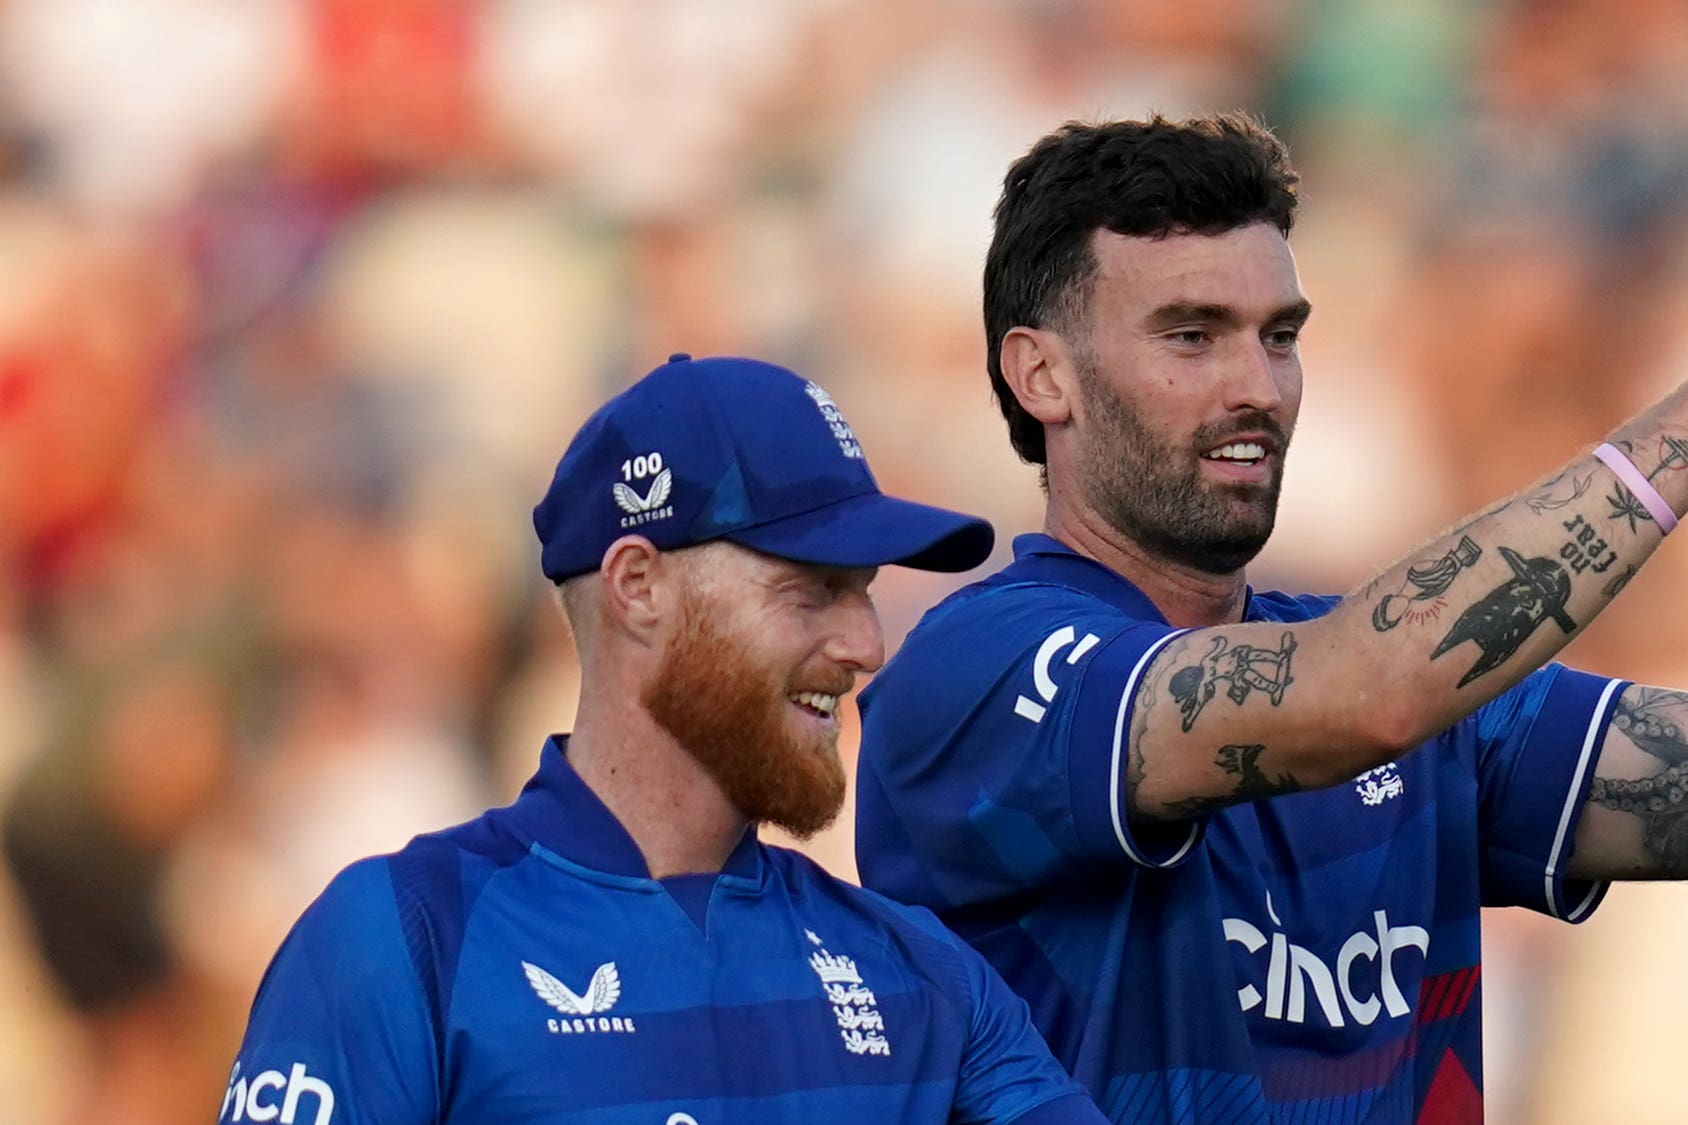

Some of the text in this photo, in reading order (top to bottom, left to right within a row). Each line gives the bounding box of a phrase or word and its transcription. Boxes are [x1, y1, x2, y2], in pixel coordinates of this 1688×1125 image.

[621, 452, 662, 481] 100
[620, 505, 673, 528] CASTORE
[547, 1017, 636, 1034] CASTORE
